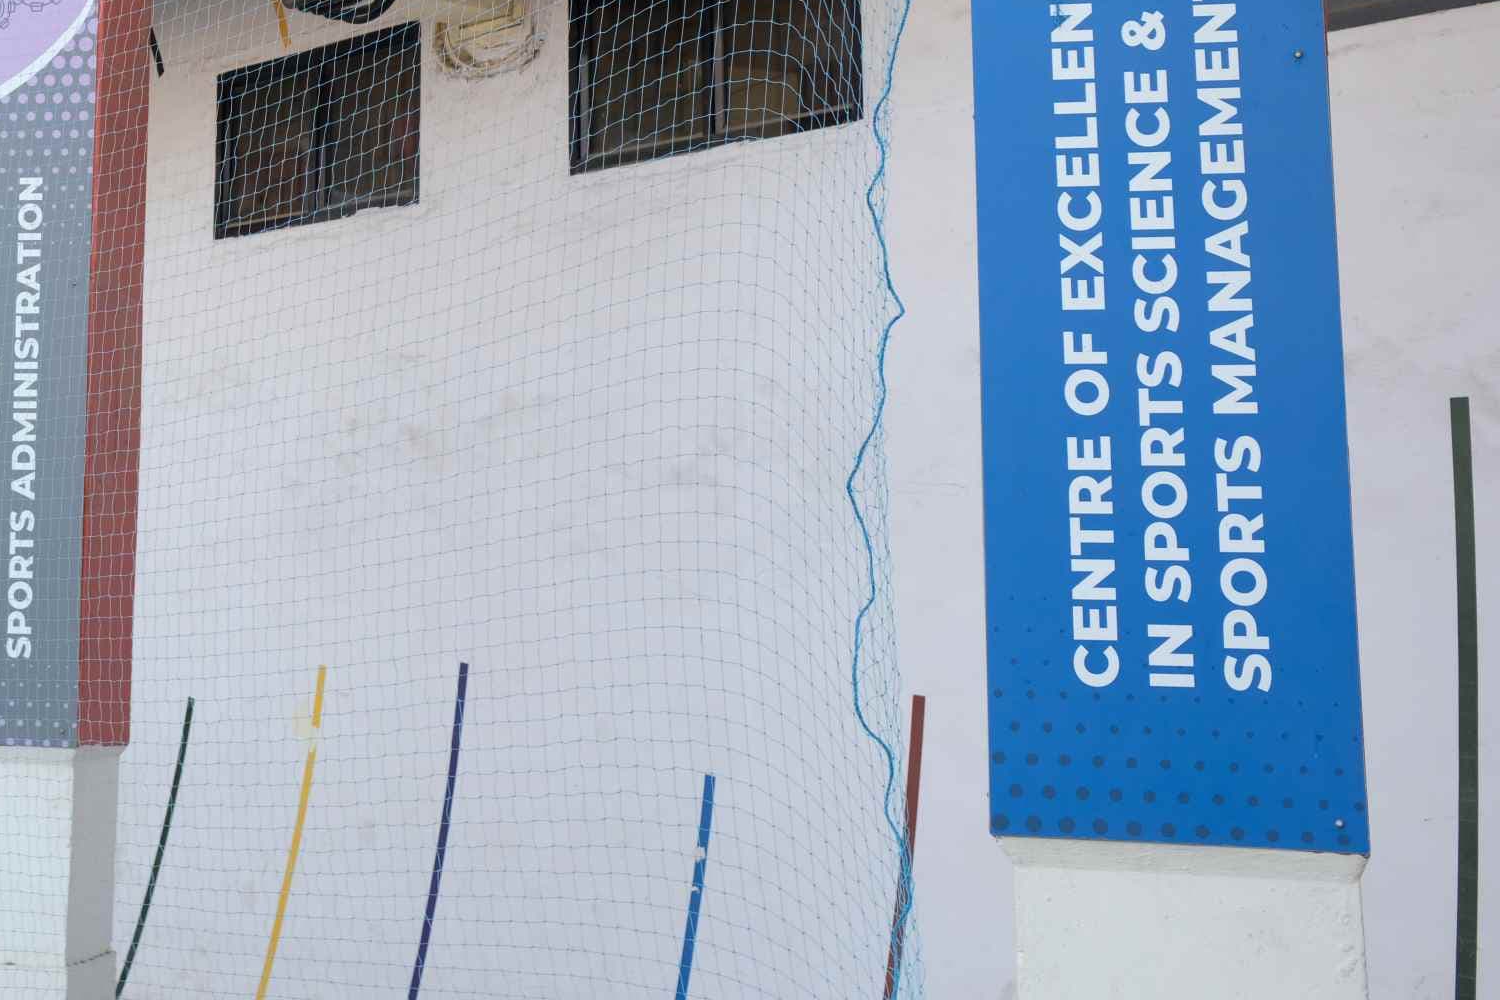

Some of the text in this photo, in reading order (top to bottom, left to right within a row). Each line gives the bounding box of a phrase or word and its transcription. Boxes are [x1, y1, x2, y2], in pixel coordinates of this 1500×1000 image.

[6, 176, 44, 658] SPORTS ADMINISTRATION
[1063, 331, 1110, 416] OF
[1121, 10, 1195, 688] IN SPORTS SCIENCE &
[1067, 436, 1120, 687] CENTRE
[1214, 435, 1272, 692] SPORTS
